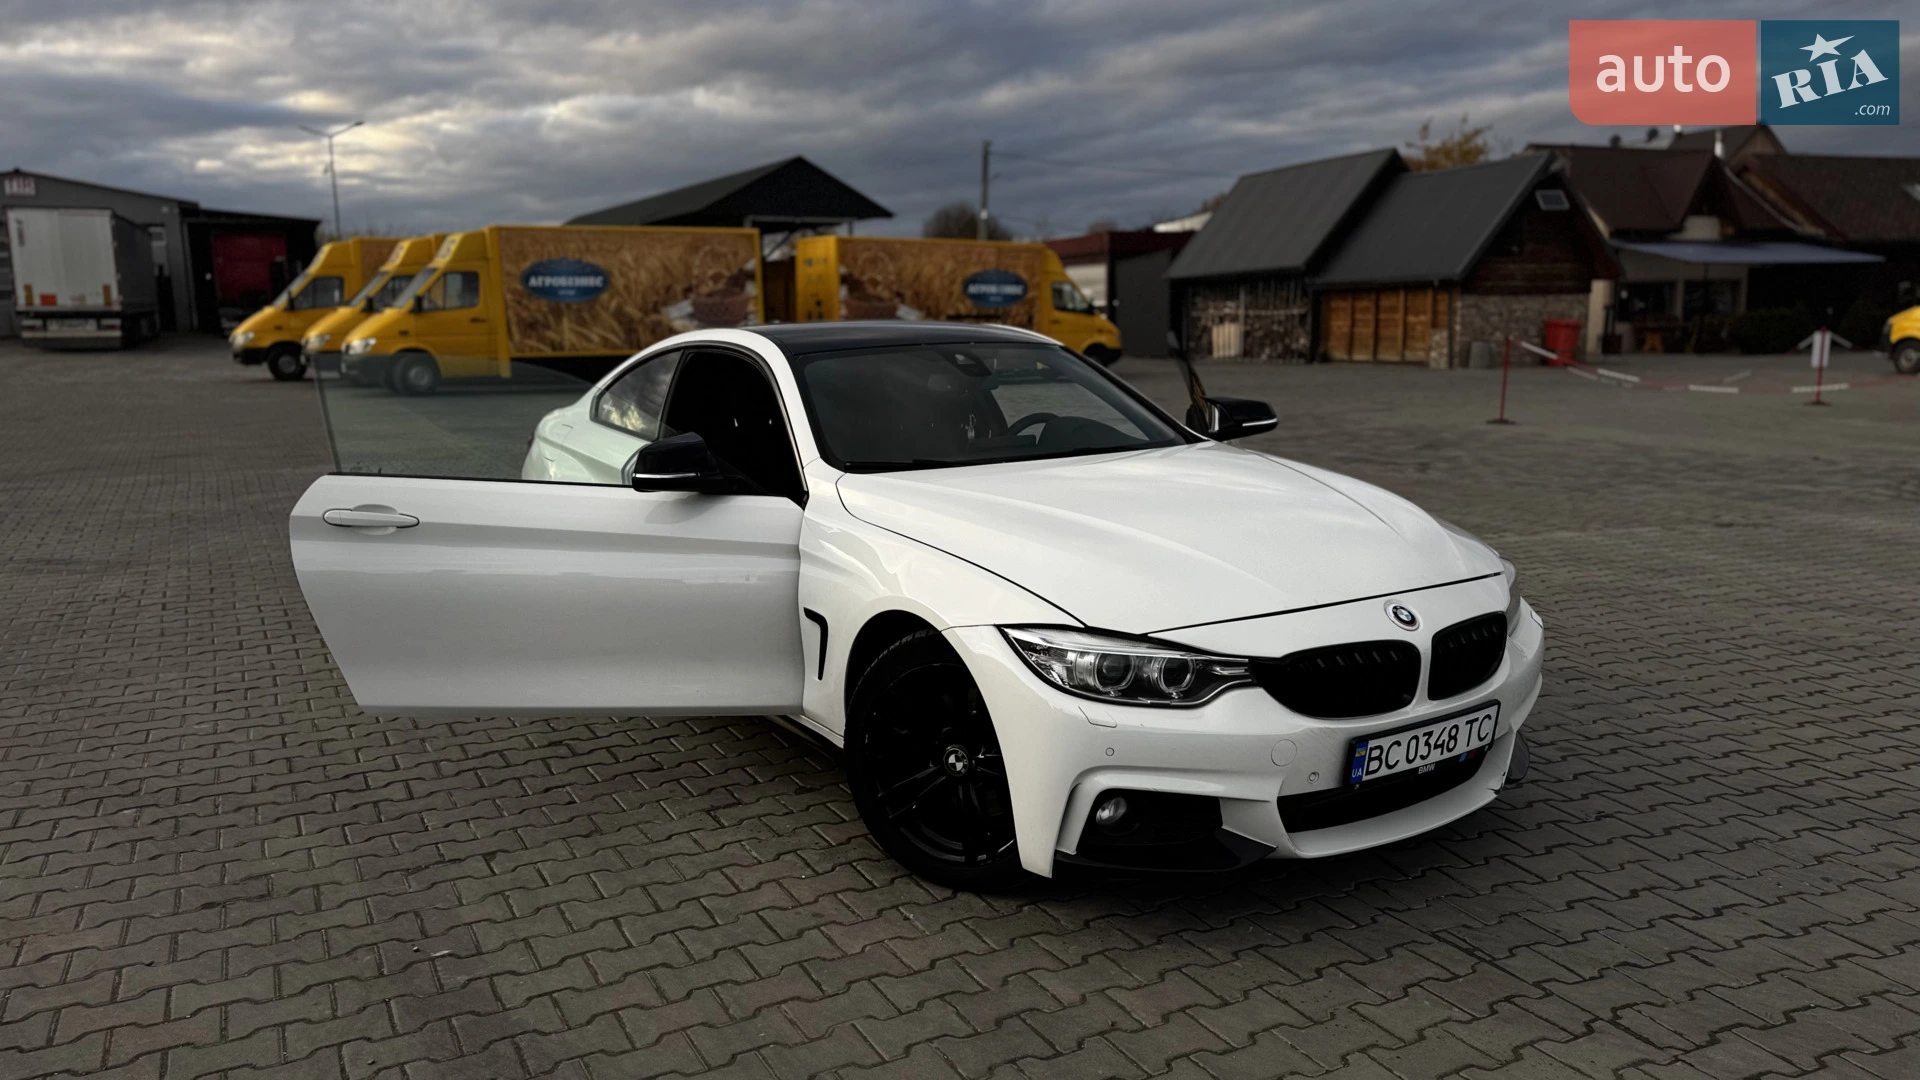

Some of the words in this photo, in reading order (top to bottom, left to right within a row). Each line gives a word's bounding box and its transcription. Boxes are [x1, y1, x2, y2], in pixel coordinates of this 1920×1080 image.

[1365, 740, 1401, 776] BC
[1405, 724, 1459, 764] 0348
[1465, 714, 1492, 747] TC
[1352, 768, 1362, 778] UA
[1418, 763, 1436, 774] BMW
